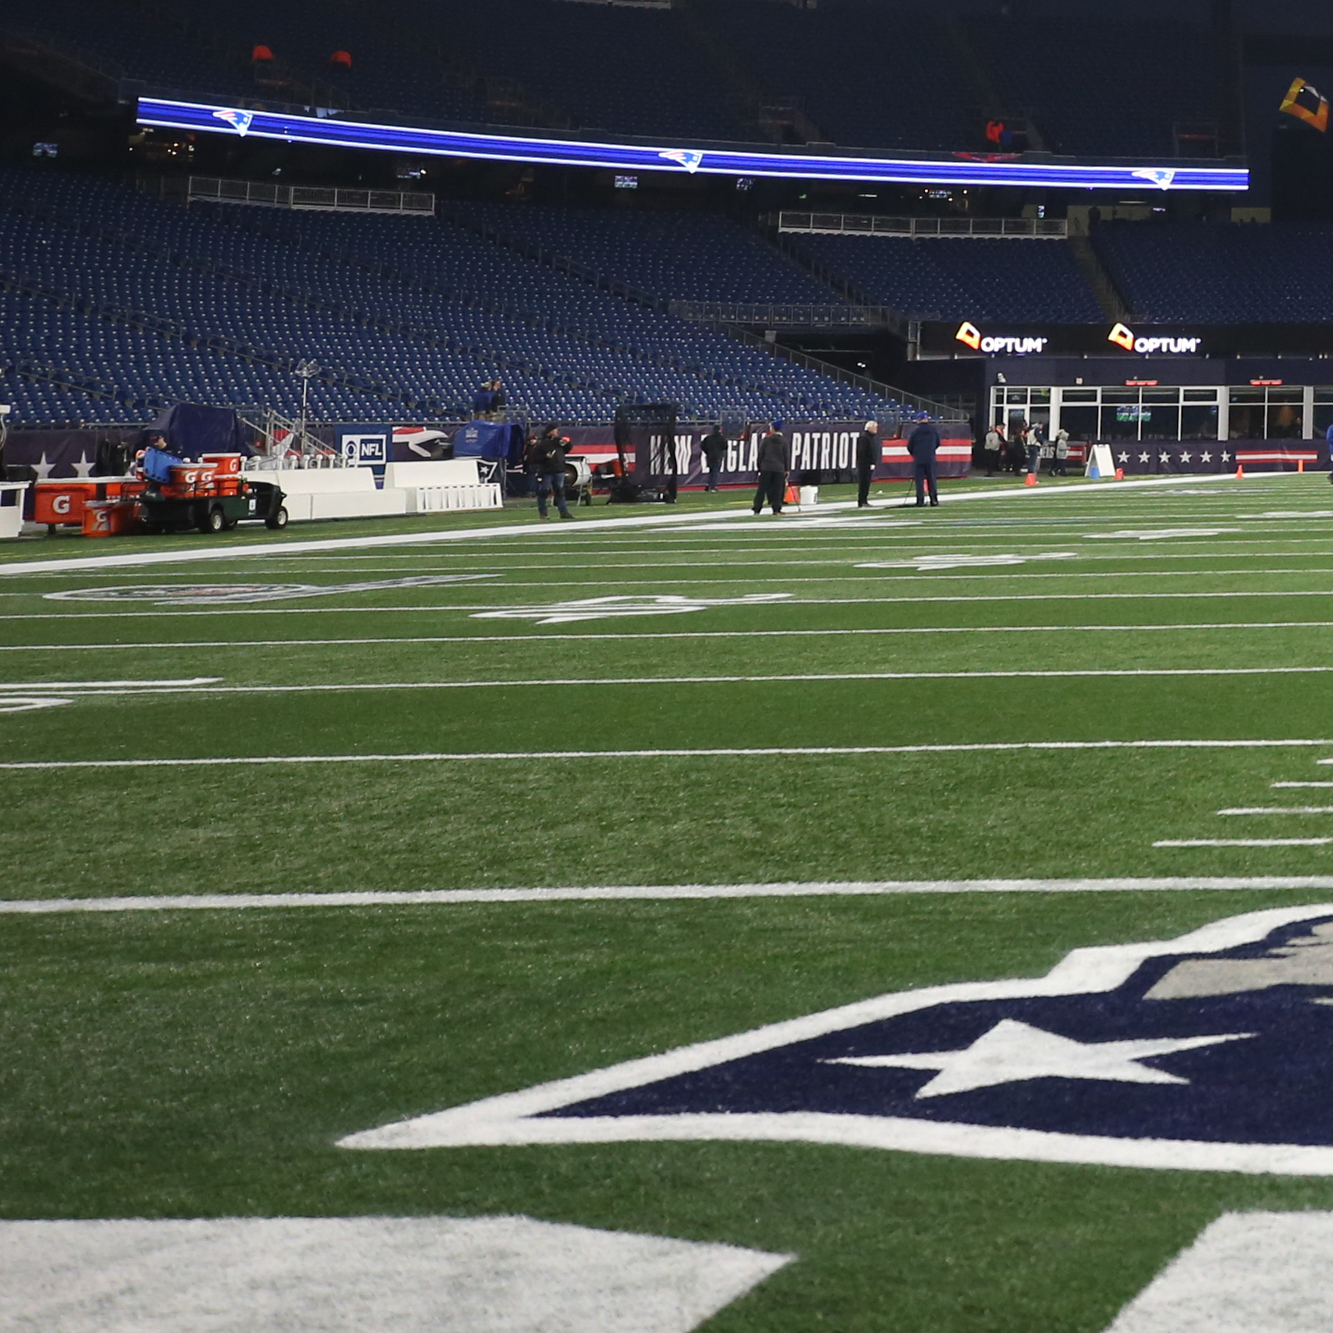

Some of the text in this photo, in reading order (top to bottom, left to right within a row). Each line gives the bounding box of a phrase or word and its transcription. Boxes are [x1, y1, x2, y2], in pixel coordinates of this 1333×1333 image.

[981, 337, 1043, 353] OPTUM
[1134, 337, 1196, 354] OPTUM
[361, 443, 382, 457] NFL
[53, 495, 70, 514] G
